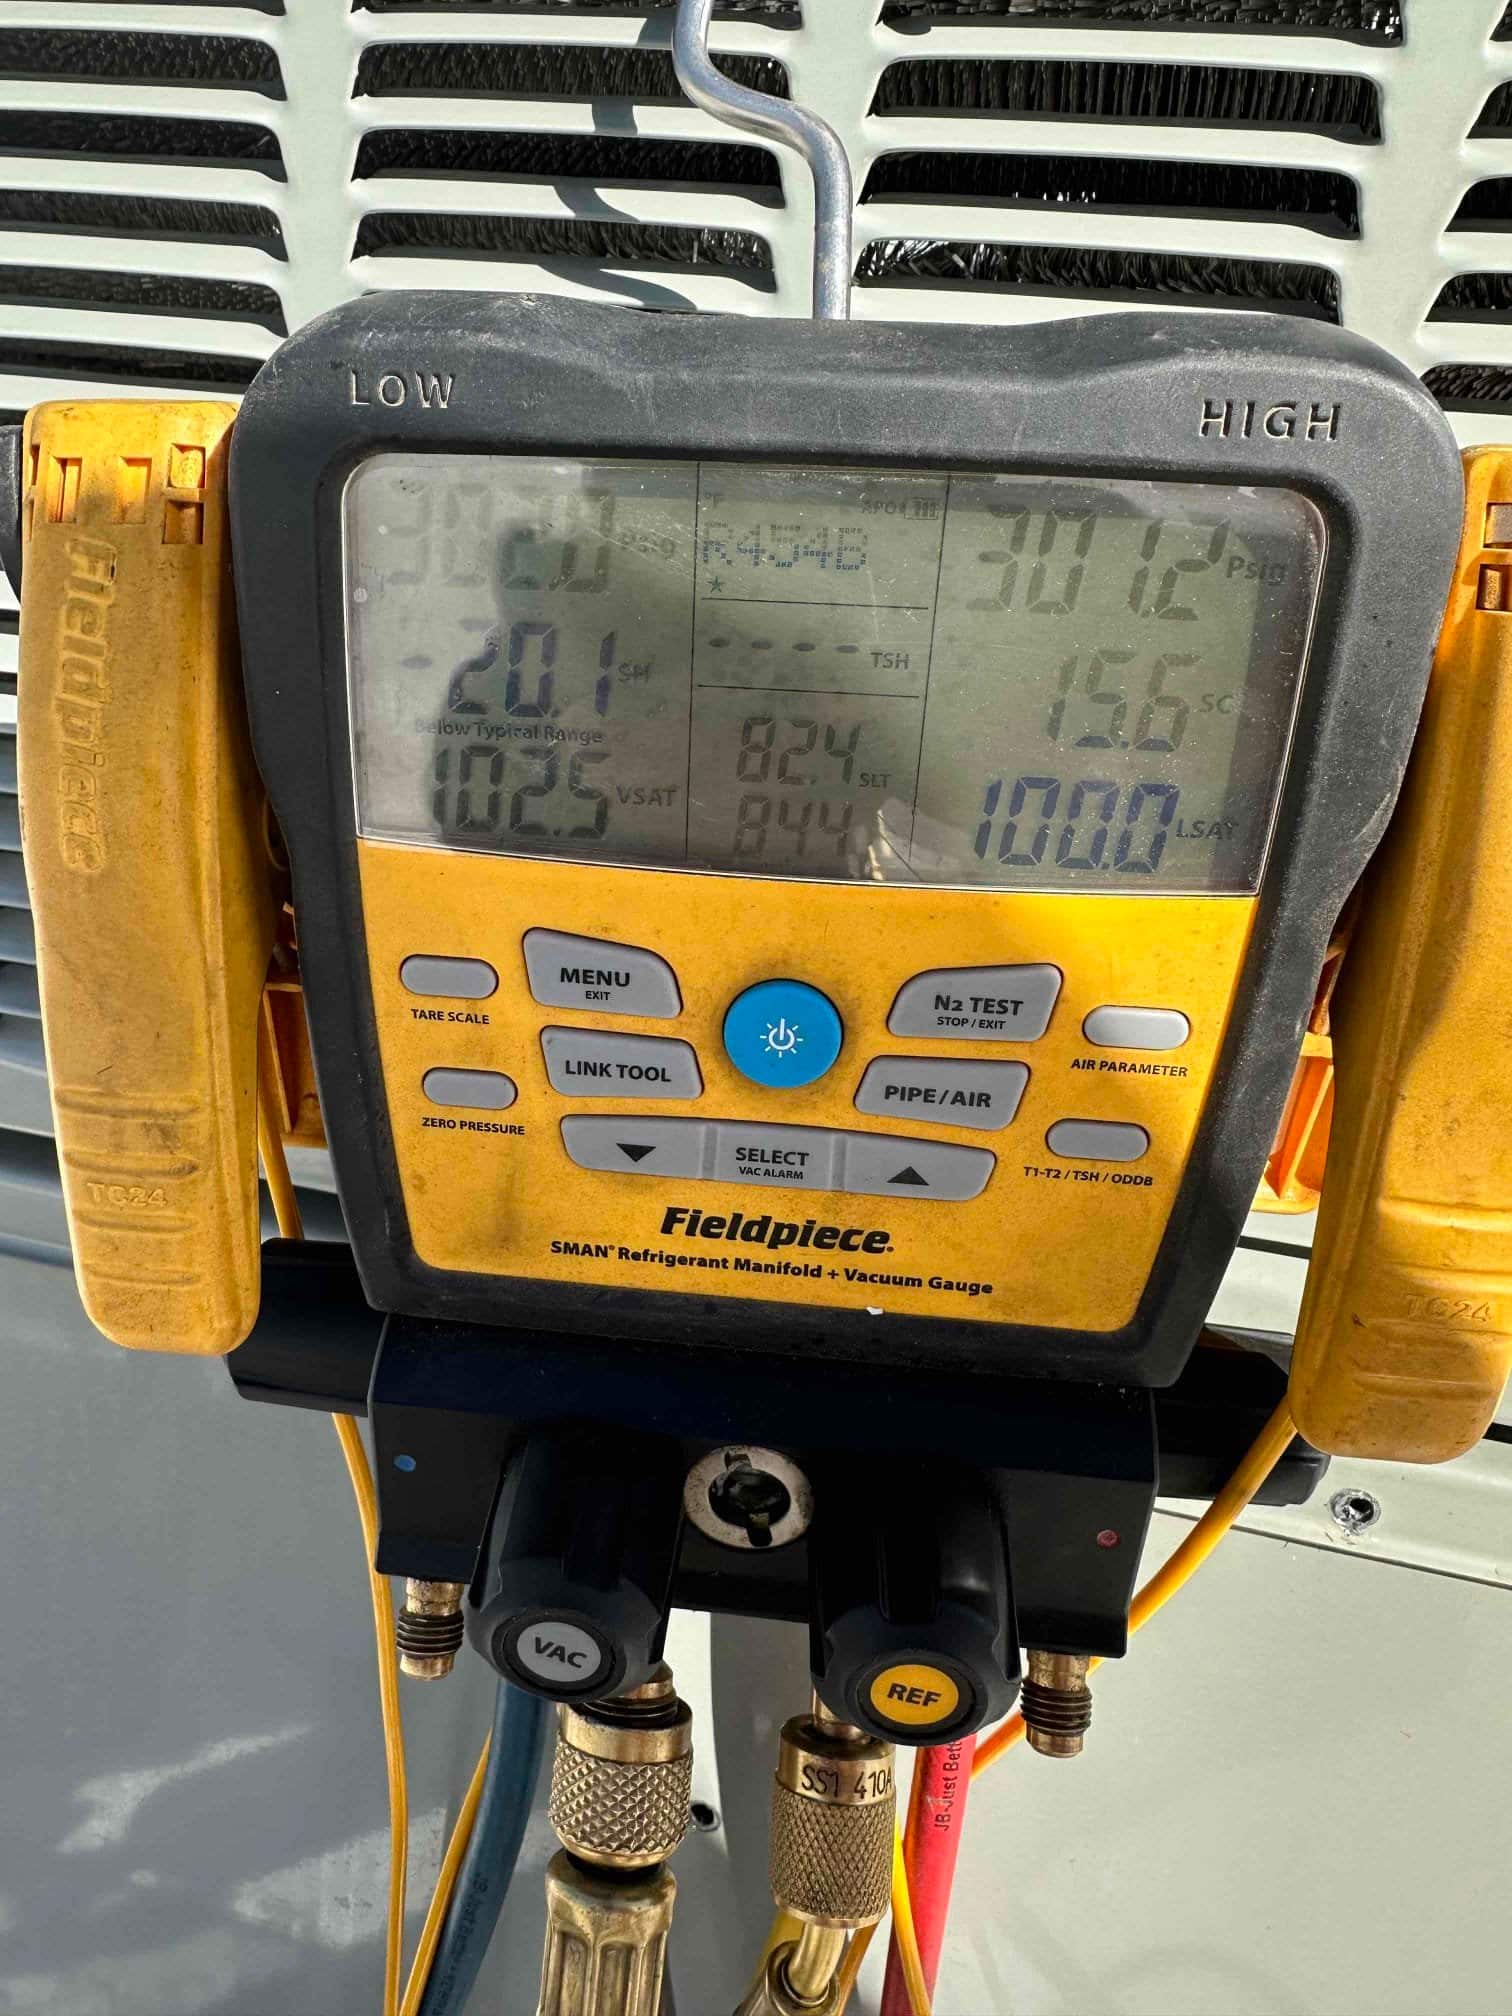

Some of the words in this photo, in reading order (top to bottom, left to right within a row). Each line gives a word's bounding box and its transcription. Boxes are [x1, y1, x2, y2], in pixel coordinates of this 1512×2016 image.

[351, 371, 455, 408] LOW
[1199, 399, 1340, 441] HIGH
[703, 520, 869, 571] R454B
[966, 503, 1231, 621] 307.2
[1226, 555, 1287, 586] Psig
[871, 651, 910, 670] TSH
[1048, 650, 1202, 752] 15.6
[1199, 693, 1234, 715] SC
[415, 719, 469, 737] Below
[473, 721, 538, 744] Typical
[544, 725, 602, 746] Range
[736, 716, 861, 786] 82.4
[433, 745, 612, 839] 102.5
[615, 785, 678, 808] VSAT
[973, 776, 1180, 874] 100.0
[1175, 818, 1240, 841] LSAT
[560, 967, 631, 987] MENU
[585, 990, 611, 1001] EXIT
[934, 994, 963, 1012] N2
[969, 997, 1024, 1016] TEST
[411, 1008, 445, 1021] TARE
[447, 1011, 490, 1025] SCALE
[937, 1016, 969, 1028] STOP
[978, 1019, 1006, 1030] EXIT
[565, 1060, 612, 1078] LINK
[616, 1064, 672, 1083] TOOL
[1070, 1058, 1096, 1070] AIR
[1099, 1060, 1189, 1078] PARAMETER
[421, 1117, 456, 1130] ZERO
[459, 1120, 525, 1136] PRESSURE
[735, 1146, 810, 1167] SELECT
[738, 1166, 761, 1177] VAC
[763, 1167, 804, 1180] ALARM
[1023, 1166, 1062, 1180] T1-T2
[1072, 1170, 1100, 1182] TSH
[1111, 1174, 1153, 1186] ODDB
[86, 1181, 169, 1208] TC24
[660, 1206, 891, 1254] Fieldpiece
[618, 1247, 729, 1270] Refrigerant
[734, 1258, 822, 1278] Manifold
[844, 1267, 923, 1288] Vacuum
[928, 1277, 994, 1297] Gauge
[1406, 1293, 1493, 1322] TC24
[535, 1637, 588, 1669] VAC
[887, 1683, 942, 1707] REF
[854, 1766, 892, 1800] 410A
